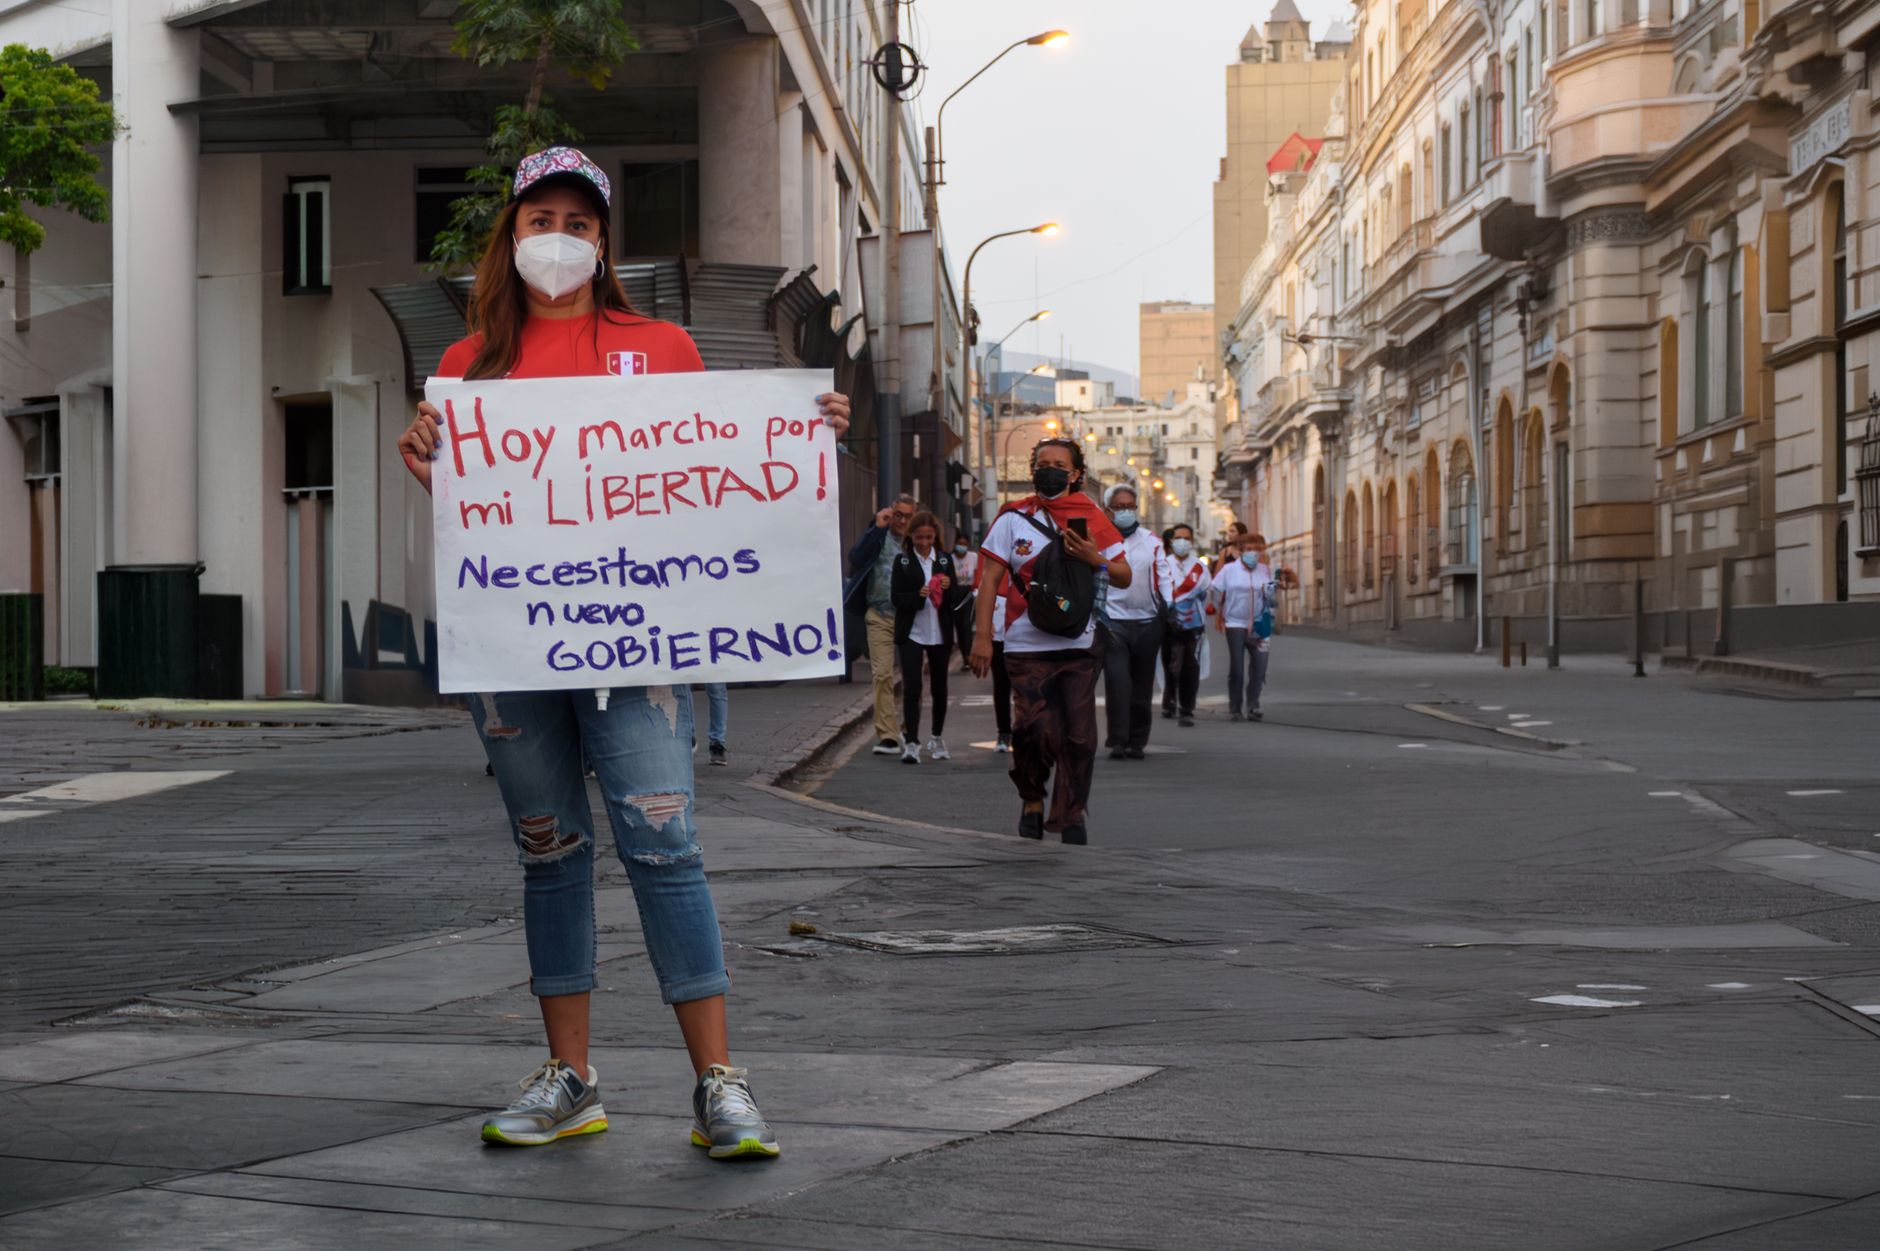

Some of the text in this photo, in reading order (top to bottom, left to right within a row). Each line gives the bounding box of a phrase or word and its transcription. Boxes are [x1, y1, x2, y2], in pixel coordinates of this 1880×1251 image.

[445, 397, 825, 480] Hoy marcho por
[460, 491, 513, 529] mi
[458, 547, 761, 589] Necesitamos
[526, 601, 645, 627] nuevo
